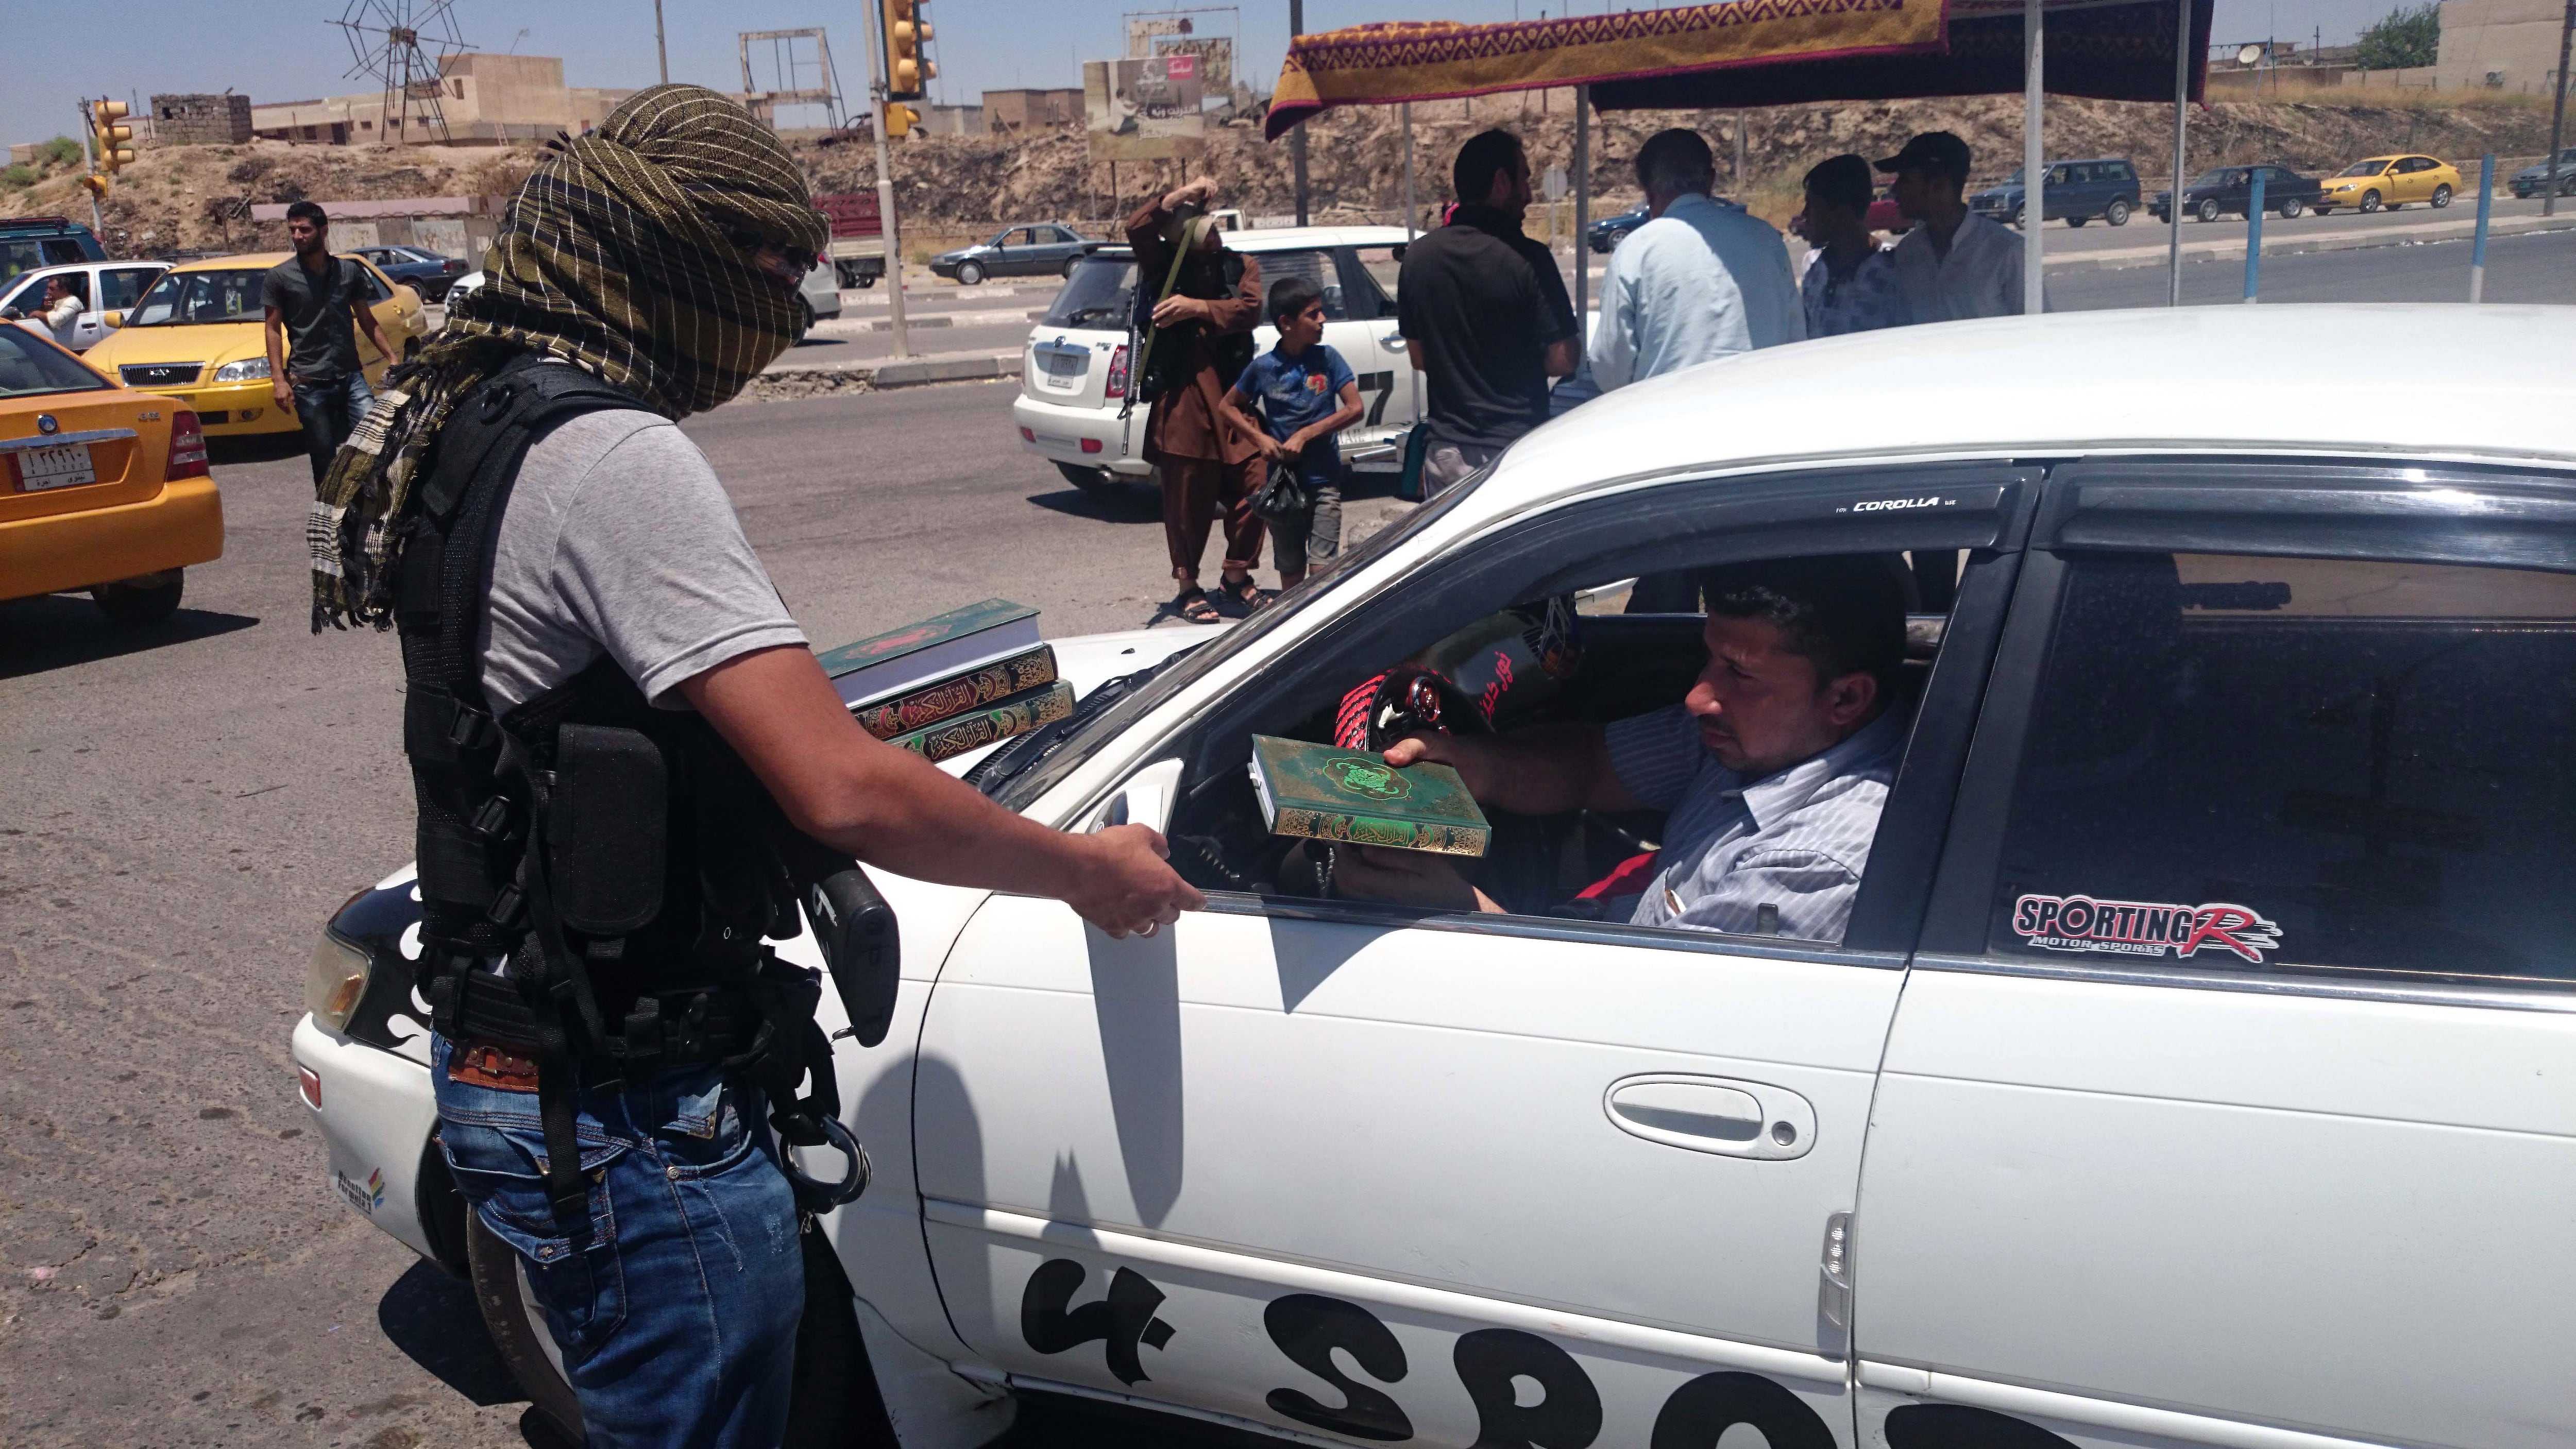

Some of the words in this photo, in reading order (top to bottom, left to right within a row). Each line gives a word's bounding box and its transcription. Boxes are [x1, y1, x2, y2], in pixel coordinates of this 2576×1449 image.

[1358, 370, 1393, 427] 7
[1853, 497, 1940, 512] COROLLA
[2015, 897, 2195, 945] SPORTING
[2034, 935, 2093, 949] MOTOR
[2099, 940, 2164, 954] SPORTS
